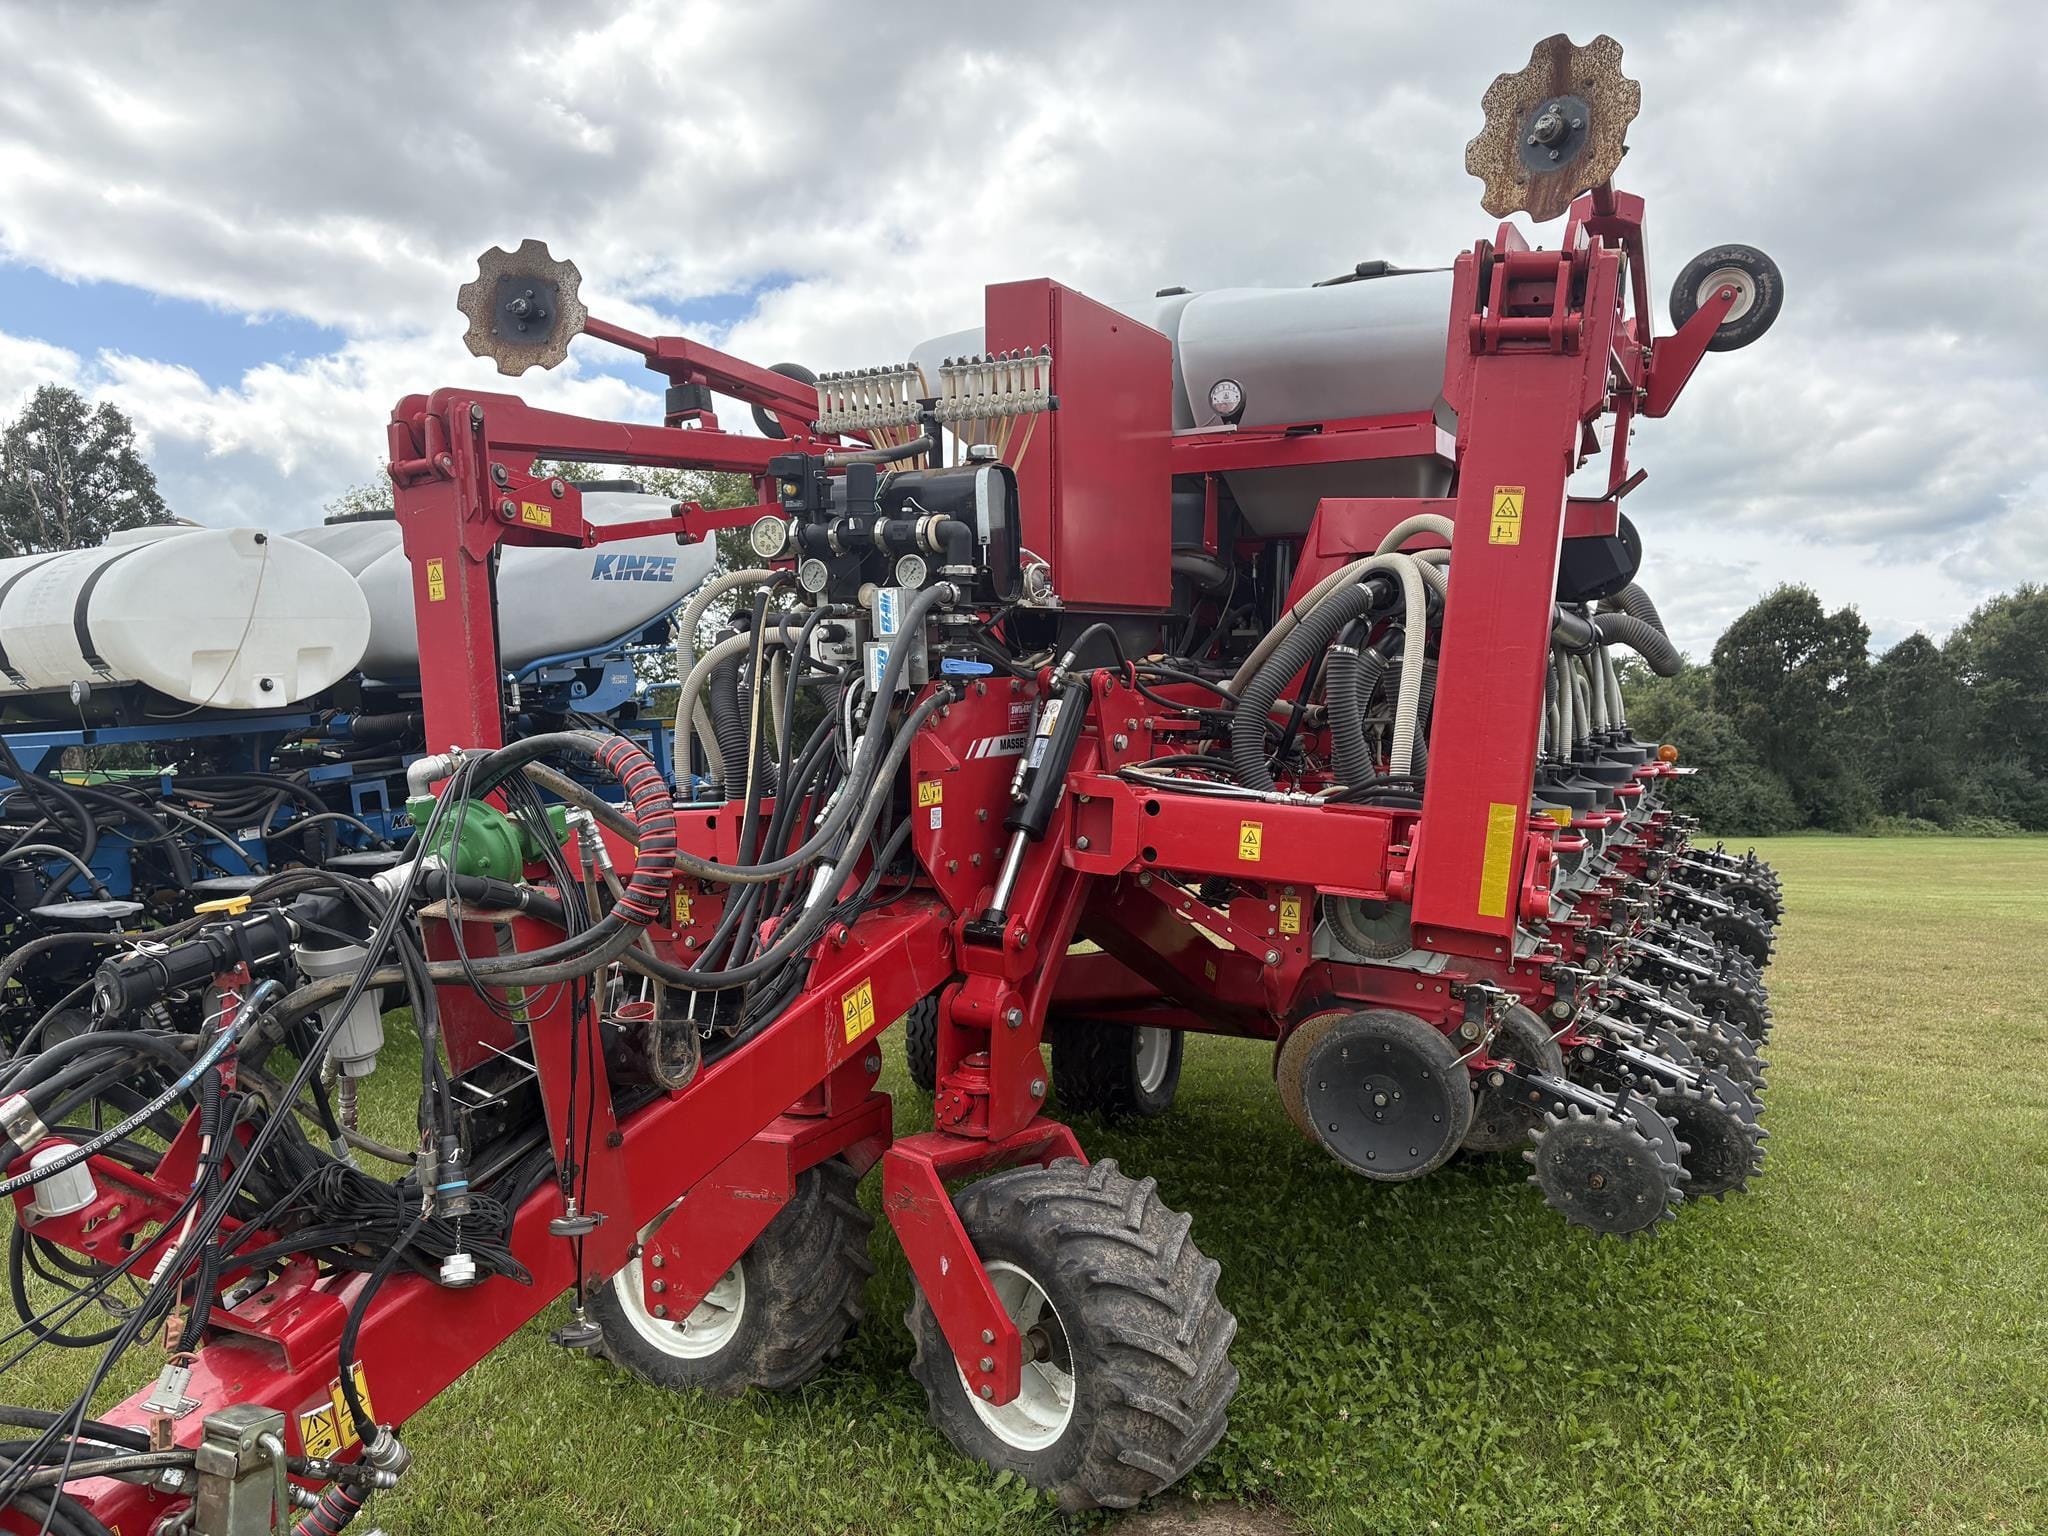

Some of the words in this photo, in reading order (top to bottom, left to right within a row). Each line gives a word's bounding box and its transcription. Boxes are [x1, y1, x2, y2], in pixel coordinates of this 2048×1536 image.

[591, 554, 677, 582] KINZE
[879, 592, 893, 633] EZ-Air
[163, 1089, 178, 1102] 22.5
[149, 1098, 166, 1113] MPa
[132, 1110, 152, 1125] (3250
[117, 1122, 133, 1135] PSI)
[86, 1141, 102, 1153] (9.5
[67, 1149, 86, 1164] mm)
[16, 1174, 32, 1186] R17
[0, 1183, 11, 1193] SA
